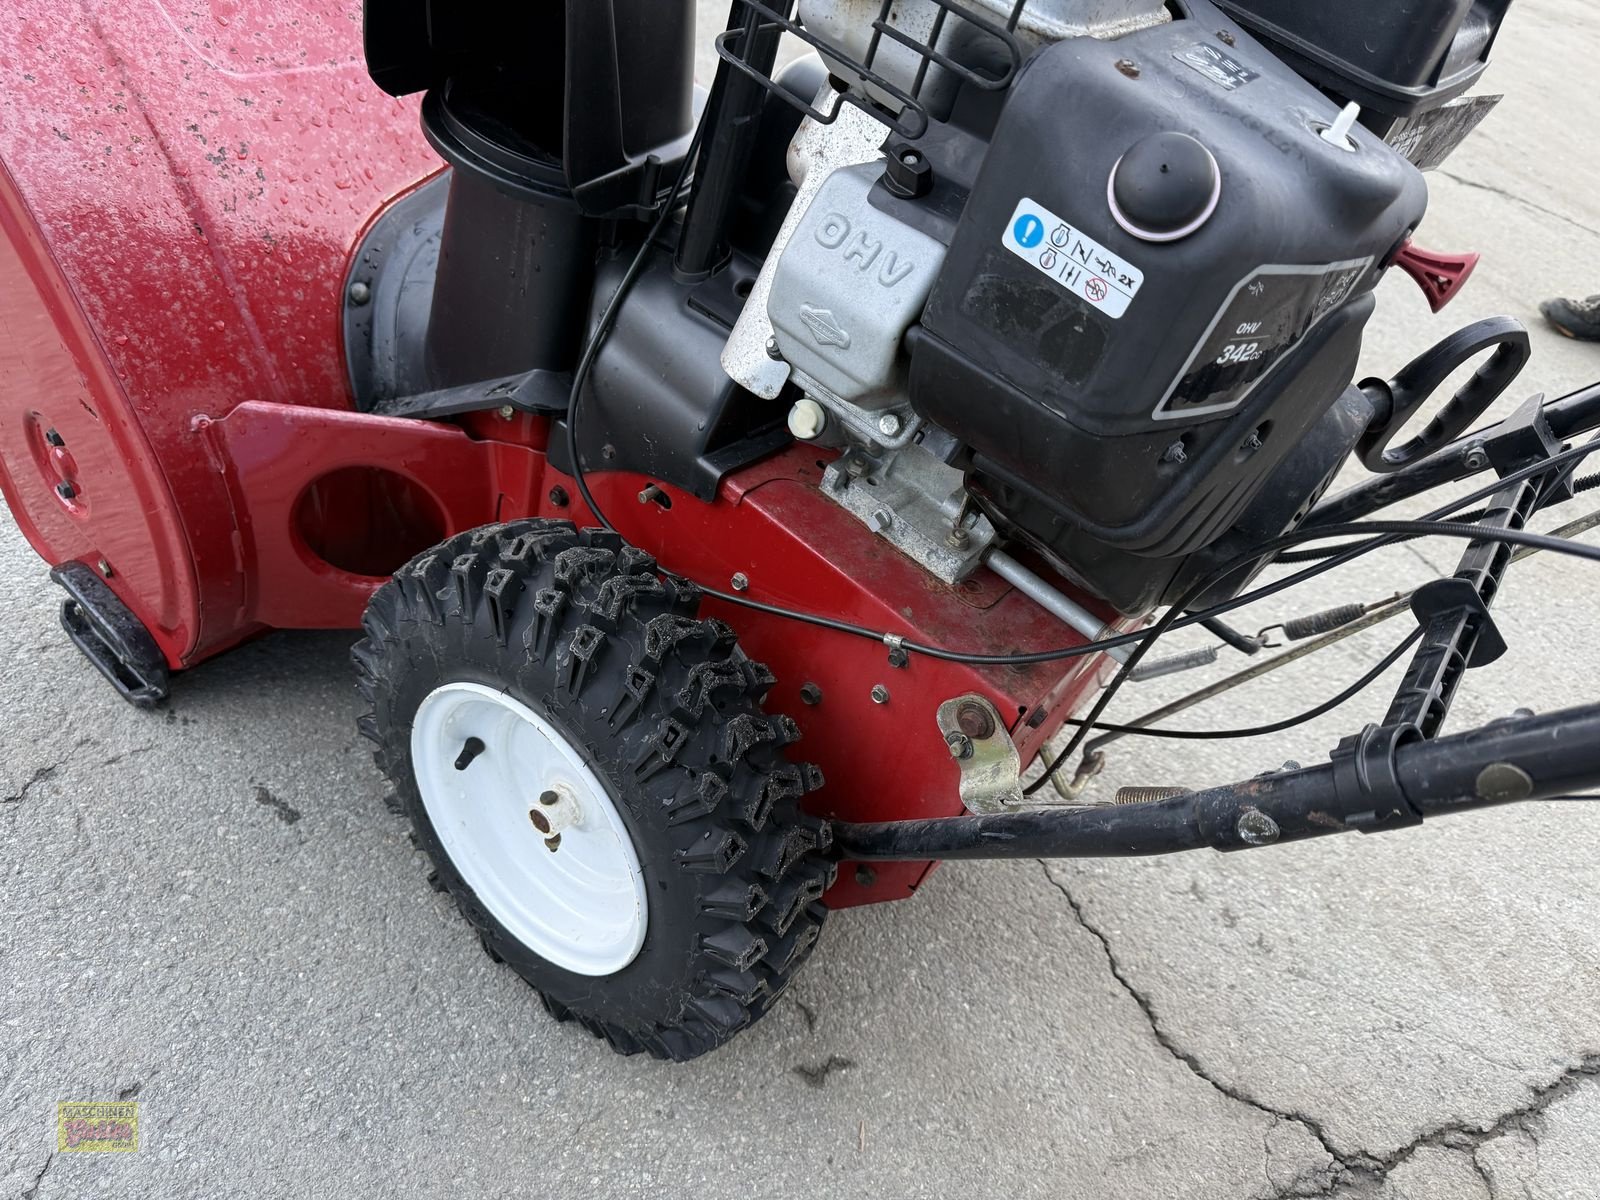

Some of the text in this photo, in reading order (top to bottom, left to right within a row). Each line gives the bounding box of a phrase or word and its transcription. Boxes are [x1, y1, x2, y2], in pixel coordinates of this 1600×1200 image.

[814, 212, 914, 287] OHV
[1118, 274, 1135, 289] 2X
[1236, 321, 1262, 334] OHV
